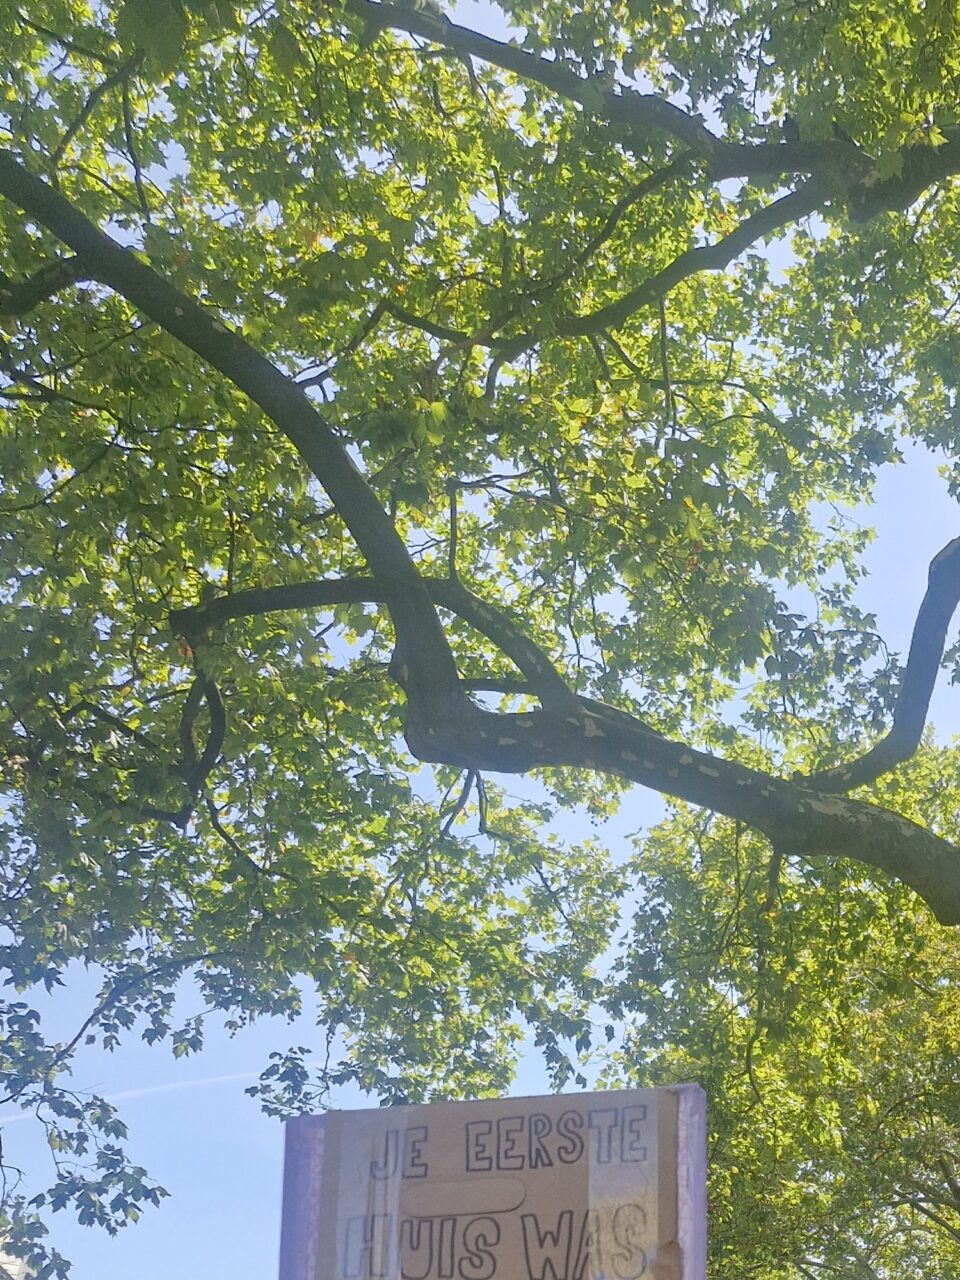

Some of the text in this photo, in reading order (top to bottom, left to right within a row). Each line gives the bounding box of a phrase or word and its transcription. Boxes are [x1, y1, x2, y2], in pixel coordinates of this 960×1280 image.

[371, 1105, 648, 1179] JE EERSTE
[342, 1213, 500, 1280] HUIS
